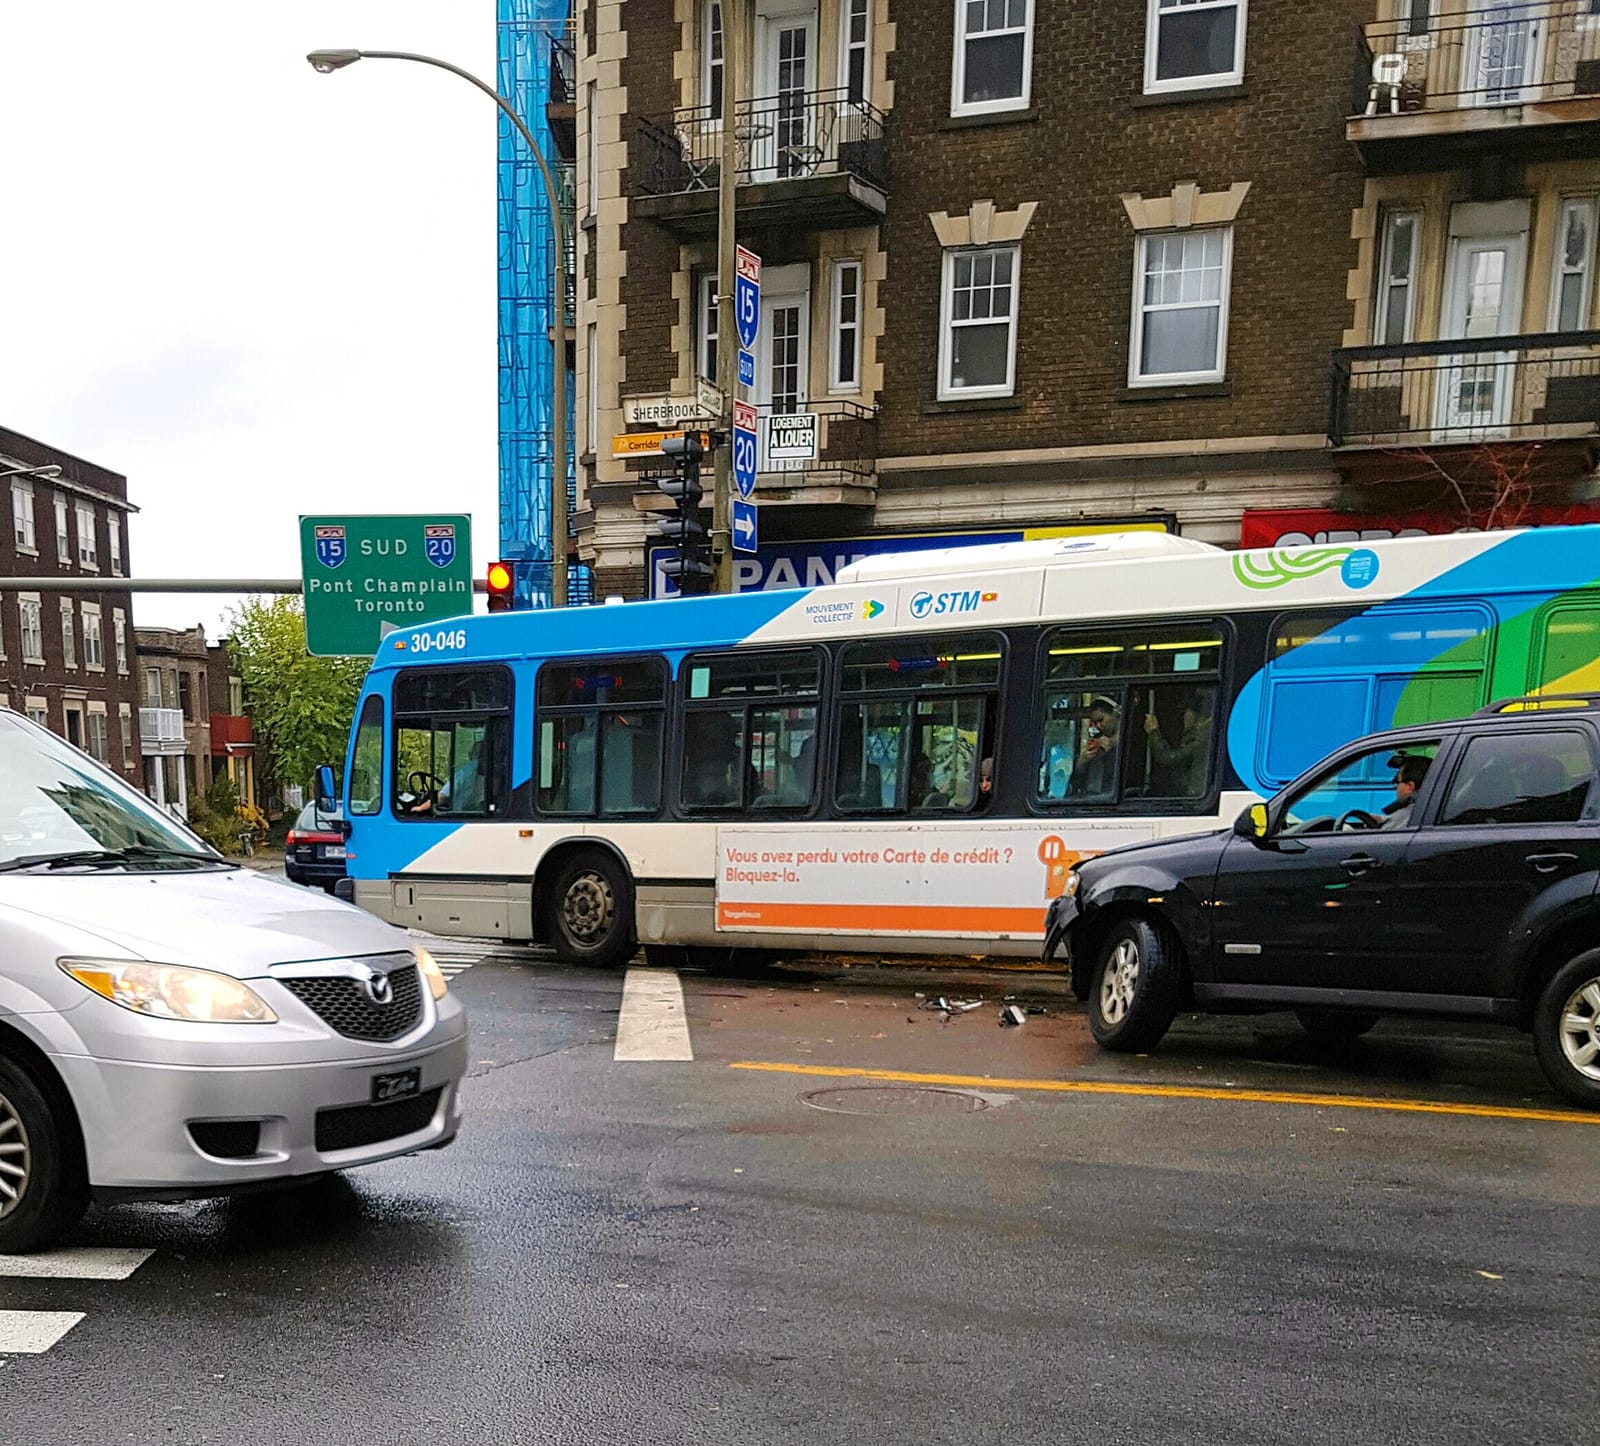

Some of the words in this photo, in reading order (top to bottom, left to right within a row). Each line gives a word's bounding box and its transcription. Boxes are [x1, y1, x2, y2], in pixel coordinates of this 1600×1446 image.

[741, 286, 754, 323] 15
[633, 404, 702, 420] SHERBROOKE
[771, 416, 812, 430] LOGEMENT
[770, 430, 778, 447] A
[780, 429, 814, 447] LOUER
[736, 437, 754, 474] 20
[320, 541, 342, 556] 15
[360, 539, 407, 555] SUD
[428, 540, 452, 556] 20
[310, 579, 353, 593] Pont
[364, 578, 466, 595] Champlain
[355, 599, 425, 612] Toronto
[806, 602, 854, 614] MOUVEMENT
[934, 591, 981, 613] STM
[813, 612, 854, 623] COLLECTIF
[411, 630, 467, 652] 30-046
[726, 848, 758, 863] Vous
[761, 852, 793, 863] avez
[797, 848, 838, 866] perdu
[842, 851, 879, 863] votre
[883, 848, 926, 864] Carte
[930, 848, 949, 863] de
[953, 848, 1000, 863] crédit
[725, 867, 800, 885] Bloquez-la.
